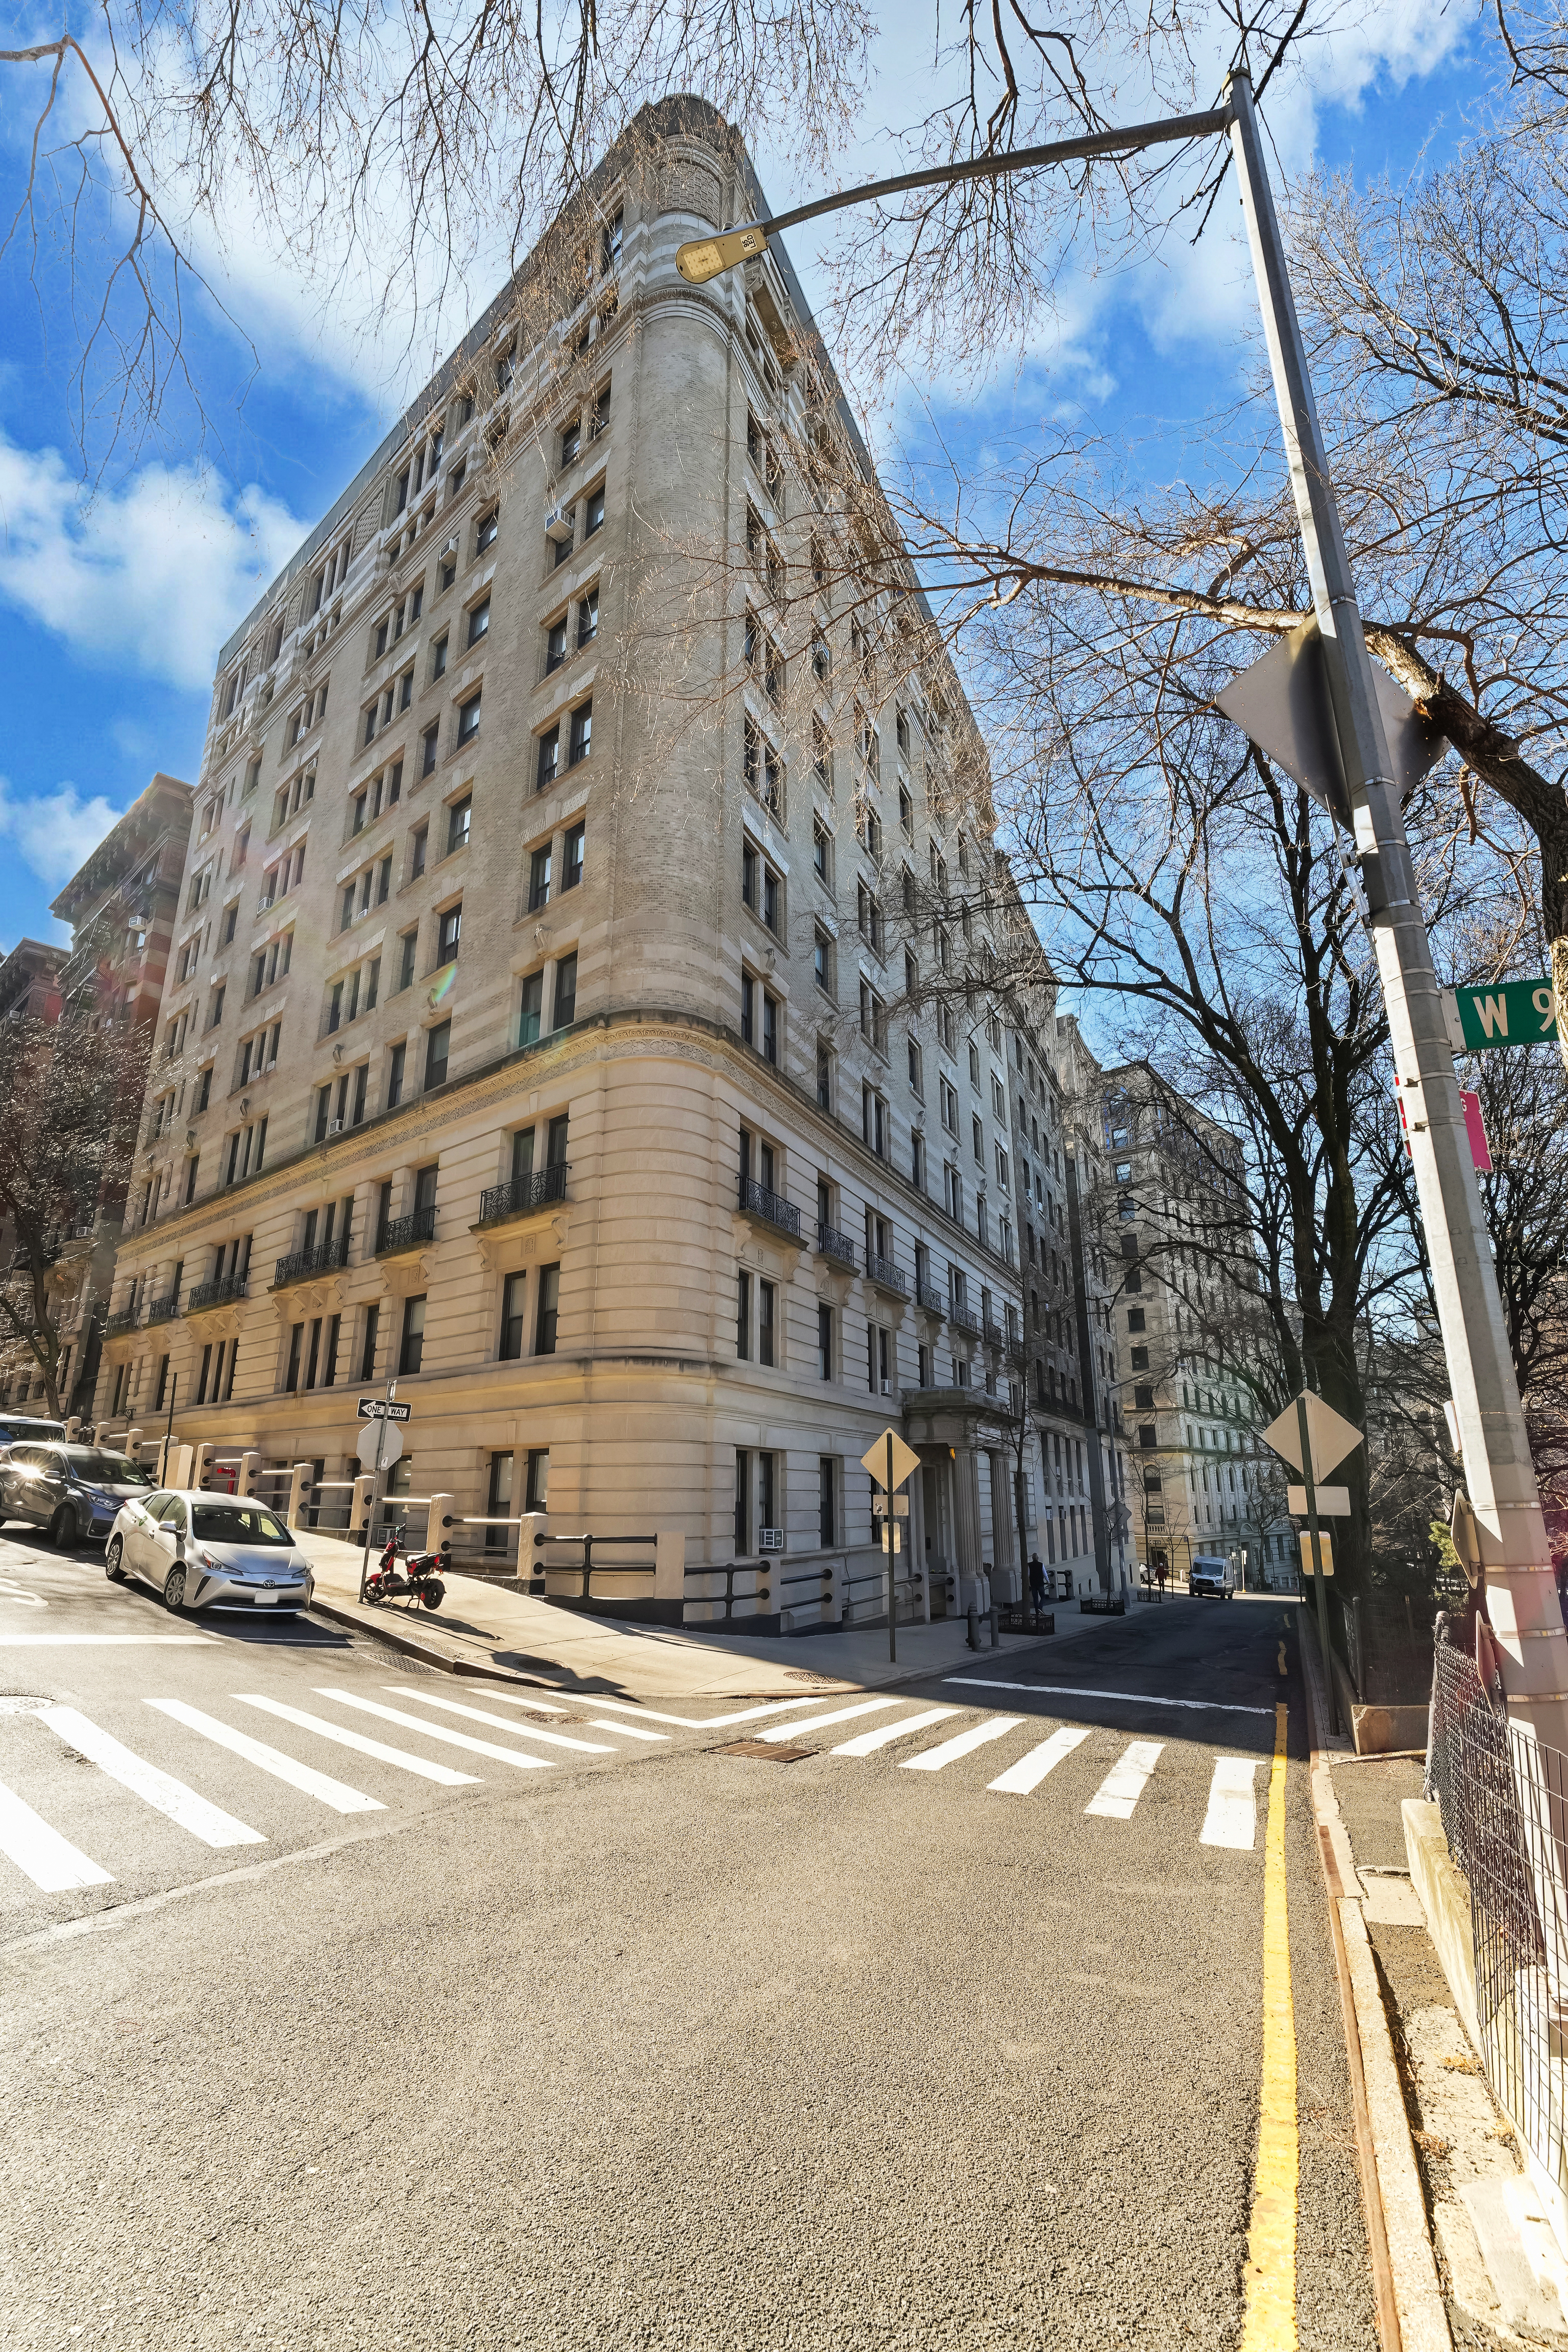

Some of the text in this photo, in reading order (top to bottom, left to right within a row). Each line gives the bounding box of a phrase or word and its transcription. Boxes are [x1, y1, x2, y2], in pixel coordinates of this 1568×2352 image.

[747, 235, 756, 248] LED
[1473, 993, 1508, 1038] W
[367, 1405, 405, 1416] ONE WAY
